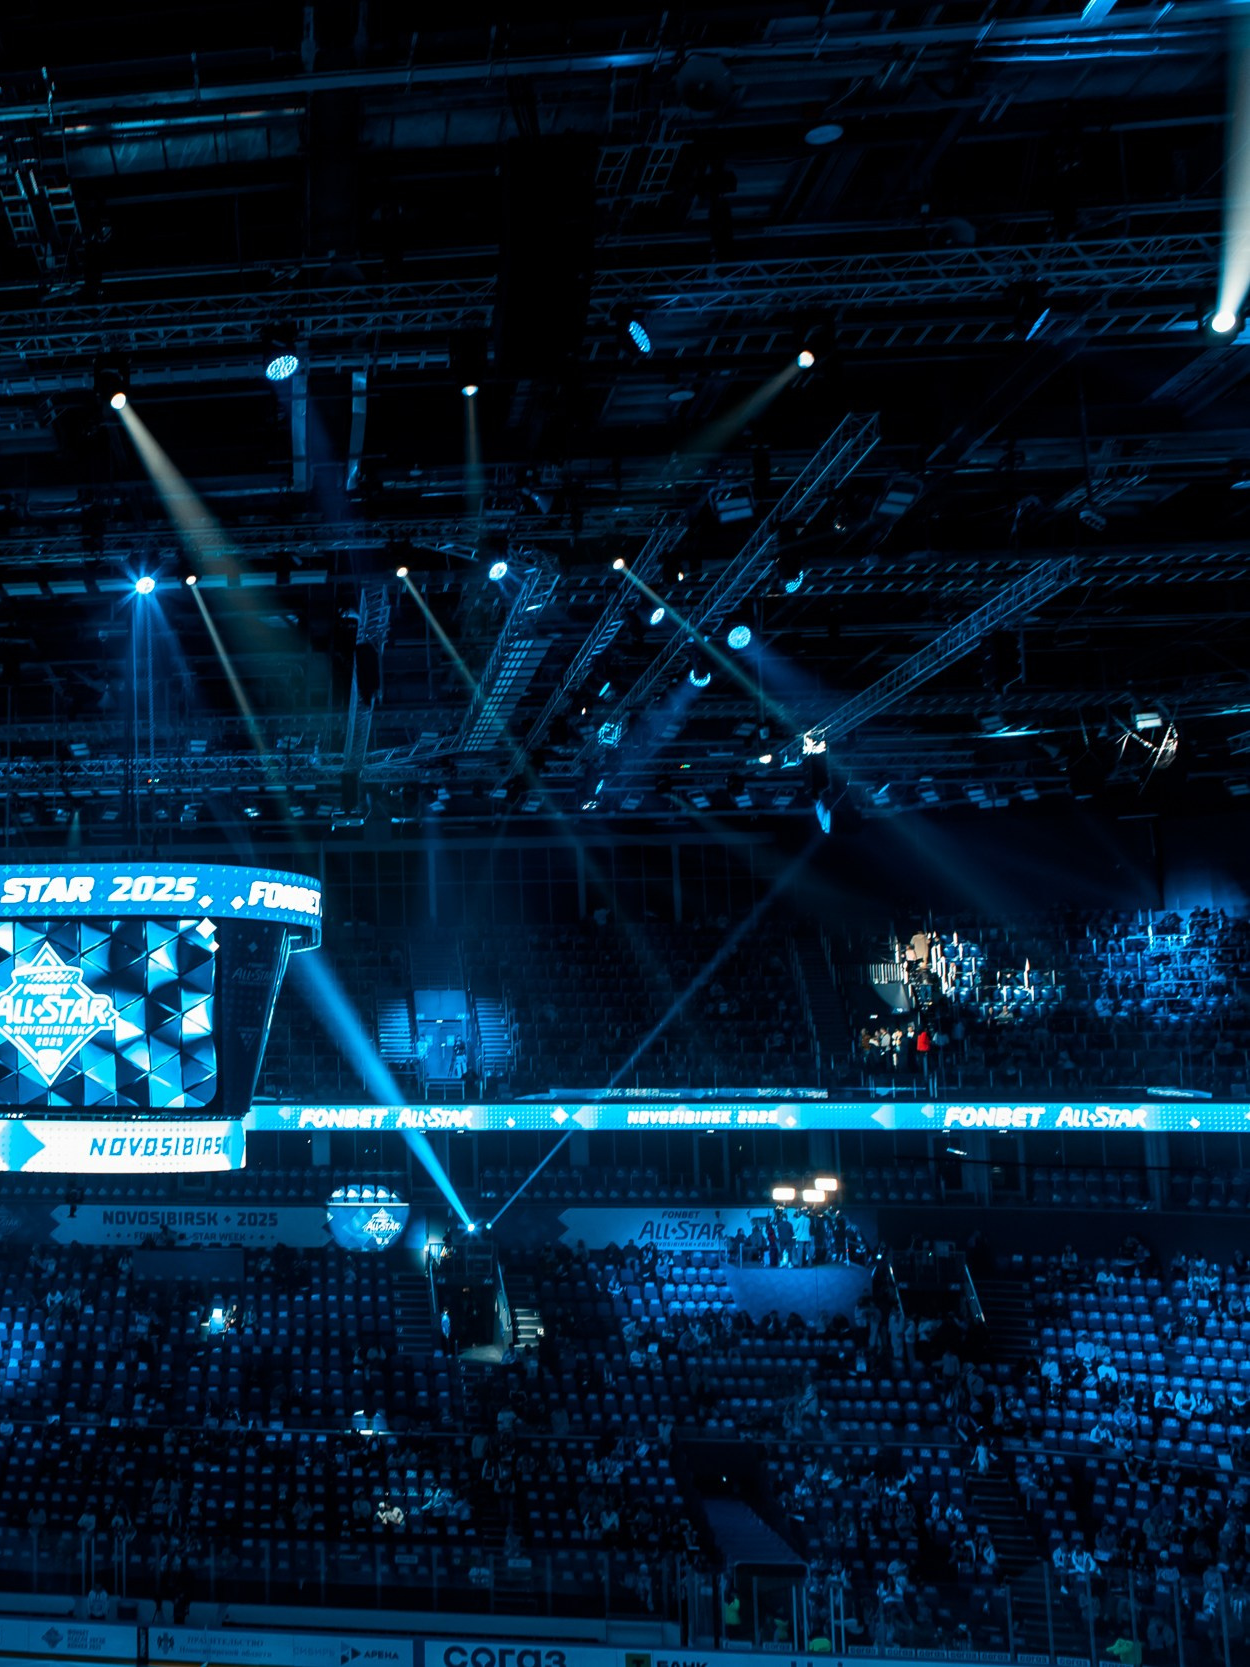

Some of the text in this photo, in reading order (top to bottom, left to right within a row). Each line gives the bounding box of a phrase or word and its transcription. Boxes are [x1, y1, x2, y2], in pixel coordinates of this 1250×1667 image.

[0, 876, 95, 903] STAR
[107, 876, 198, 902] 2025
[13, 1026, 86, 1035] NOVOSIBIRSK
[35, 1037, 63, 1047] 2025
[299, 1108, 388, 1128] FONBET
[627, 1110, 779, 1125] NOVOSIBIRSK 2025
[944, 1106, 1046, 1128] FONBET
[89, 1135, 231, 1157] NOVOSIBIRSK
[103, 1211, 278, 1227] NOVOSIBIRSK 2025
[661, 1210, 700, 1219] FONBET
[363, 1650, 399, 1660] АРЕНА
